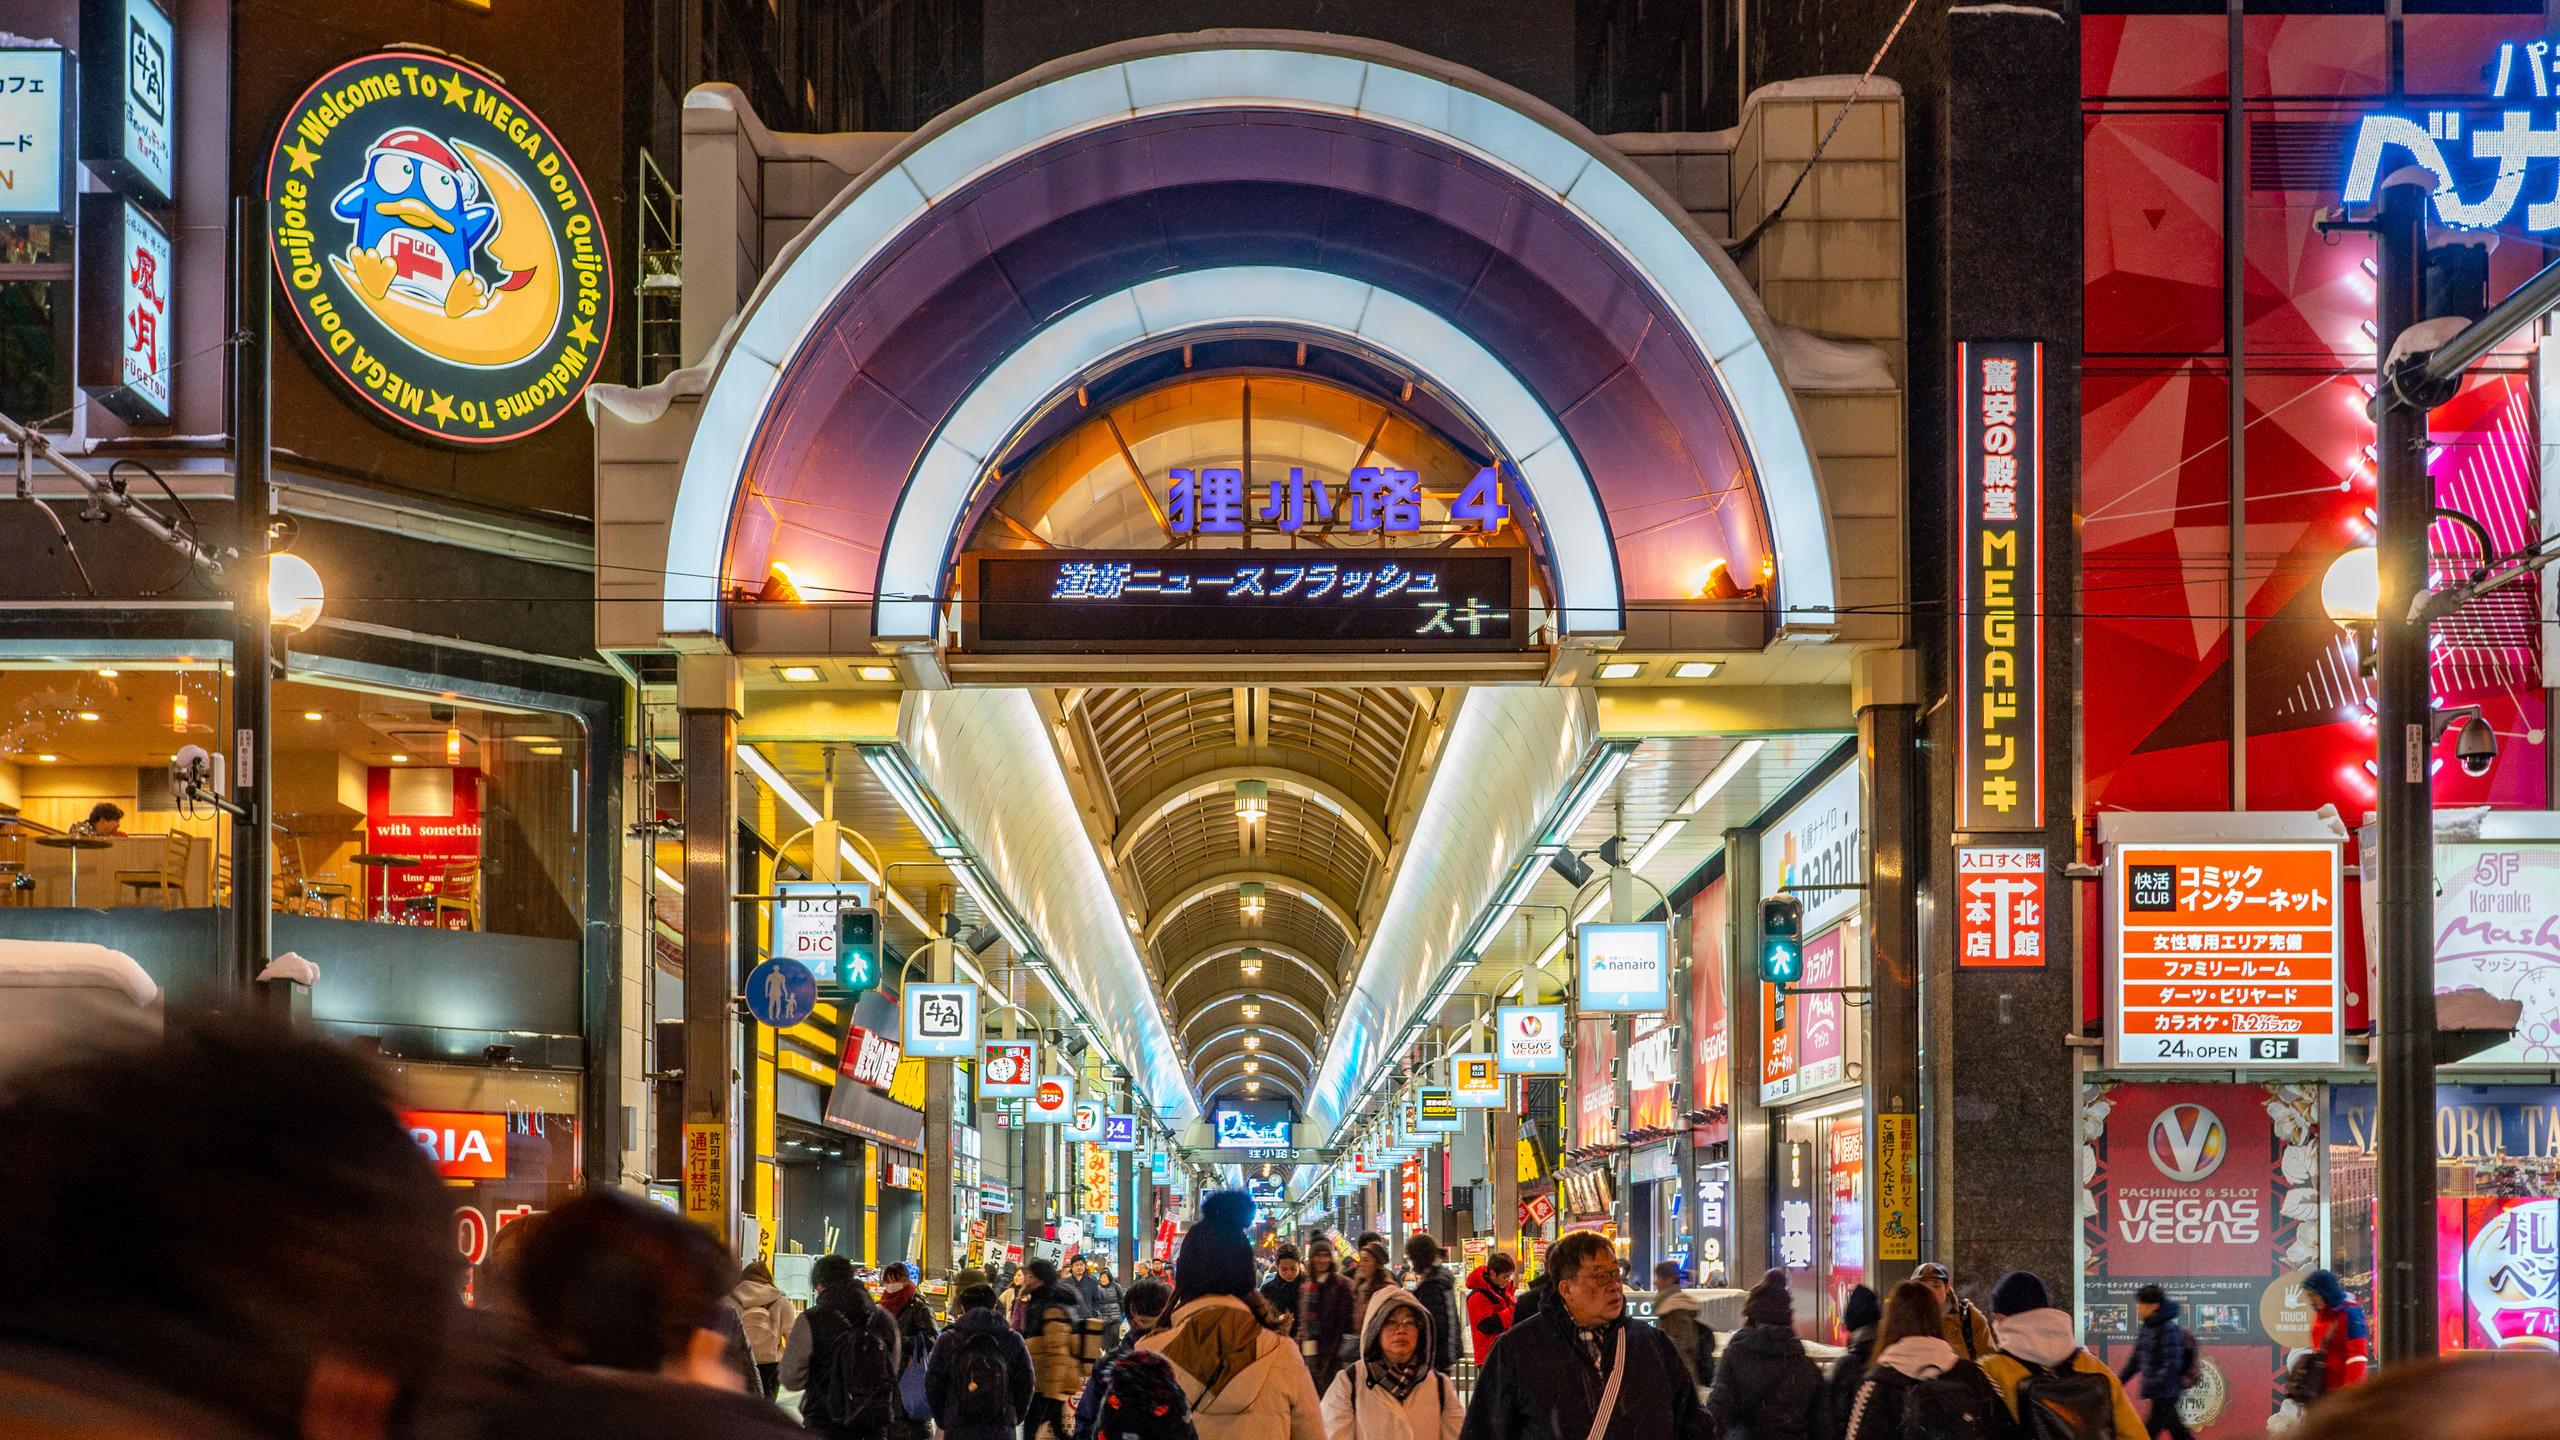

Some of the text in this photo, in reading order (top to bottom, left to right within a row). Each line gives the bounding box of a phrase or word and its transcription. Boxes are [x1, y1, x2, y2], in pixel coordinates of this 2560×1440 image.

[0, 77, 44, 93] フェ
[297, 67, 437, 146] Welcome To
[472, 87, 602, 316] MEGA Don Quijote
[278, 178, 425, 416] MEGA Don Quijote
[128, 245, 166, 374] 風月
[460, 343, 589, 430] Welcome To
[1168, 465, 1506, 534] 狸小路 4
[1051, 562, 1439, 600] 道新ニュースフラッシュ
[1982, 357, 2018, 814] 驚安の殿堂 MEGAドンキ
[376, 823, 412, 836] with
[1802, 810, 1859, 913] nanair
[1961, 852, 2042, 870] 入口すぐ隣
[2474, 852, 2520, 886] 5F
[402, 873, 425, 882] time
[2133, 871, 2170, 890] 快活
[2179, 865, 2264, 889] コミック
[2134, 890, 2171, 906] CLUB
[2179, 887, 2329, 913] インターネット
[2469, 889, 2531, 913] Karaoke
[1965, 900, 1992, 959] 本店
[2013, 900, 2040, 958] 北館
[798, 936, 834, 952] DiC
[2153, 934, 2303, 952] 女性専用エリア完備
[815, 961, 828, 977] 4
[1608, 957, 1657, 971] nanairo
[1806, 947, 1835, 986] カラオケ
[2164, 961, 2293, 978] ファミリールーム
[2471, 957, 2530, 973] マッシュ
[1617, 992, 1631, 1007] 4
[2158, 986, 2299, 1005] ダーツ・ビリヤード
[926, 1001, 960, 1027] 牛角
[1511, 1041, 1552, 1049] VEGAS
[2157, 1038, 2238, 1058] 24h OPEN
[2259, 1039, 2289, 1058] 6F
[2347, 1105, 2503, 1158] SORO
[690, 1131, 708, 1212] 通行禁止
[709, 1131, 721, 1212] 許可車両以外
[1883, 1119, 1895, 1209] ご通行ください
[1900, 1118, 1913, 1208] 自転車から降りて
[1402, 1166, 1415, 1209] メガネ
[2119, 1188, 2259, 1198] PACHINKO & SLOT
[2118, 1199, 2260, 1222] VEGAS
[2118, 1220, 2260, 1244] VEGAS
[2279, 1311, 2308, 1323] TOUCH
